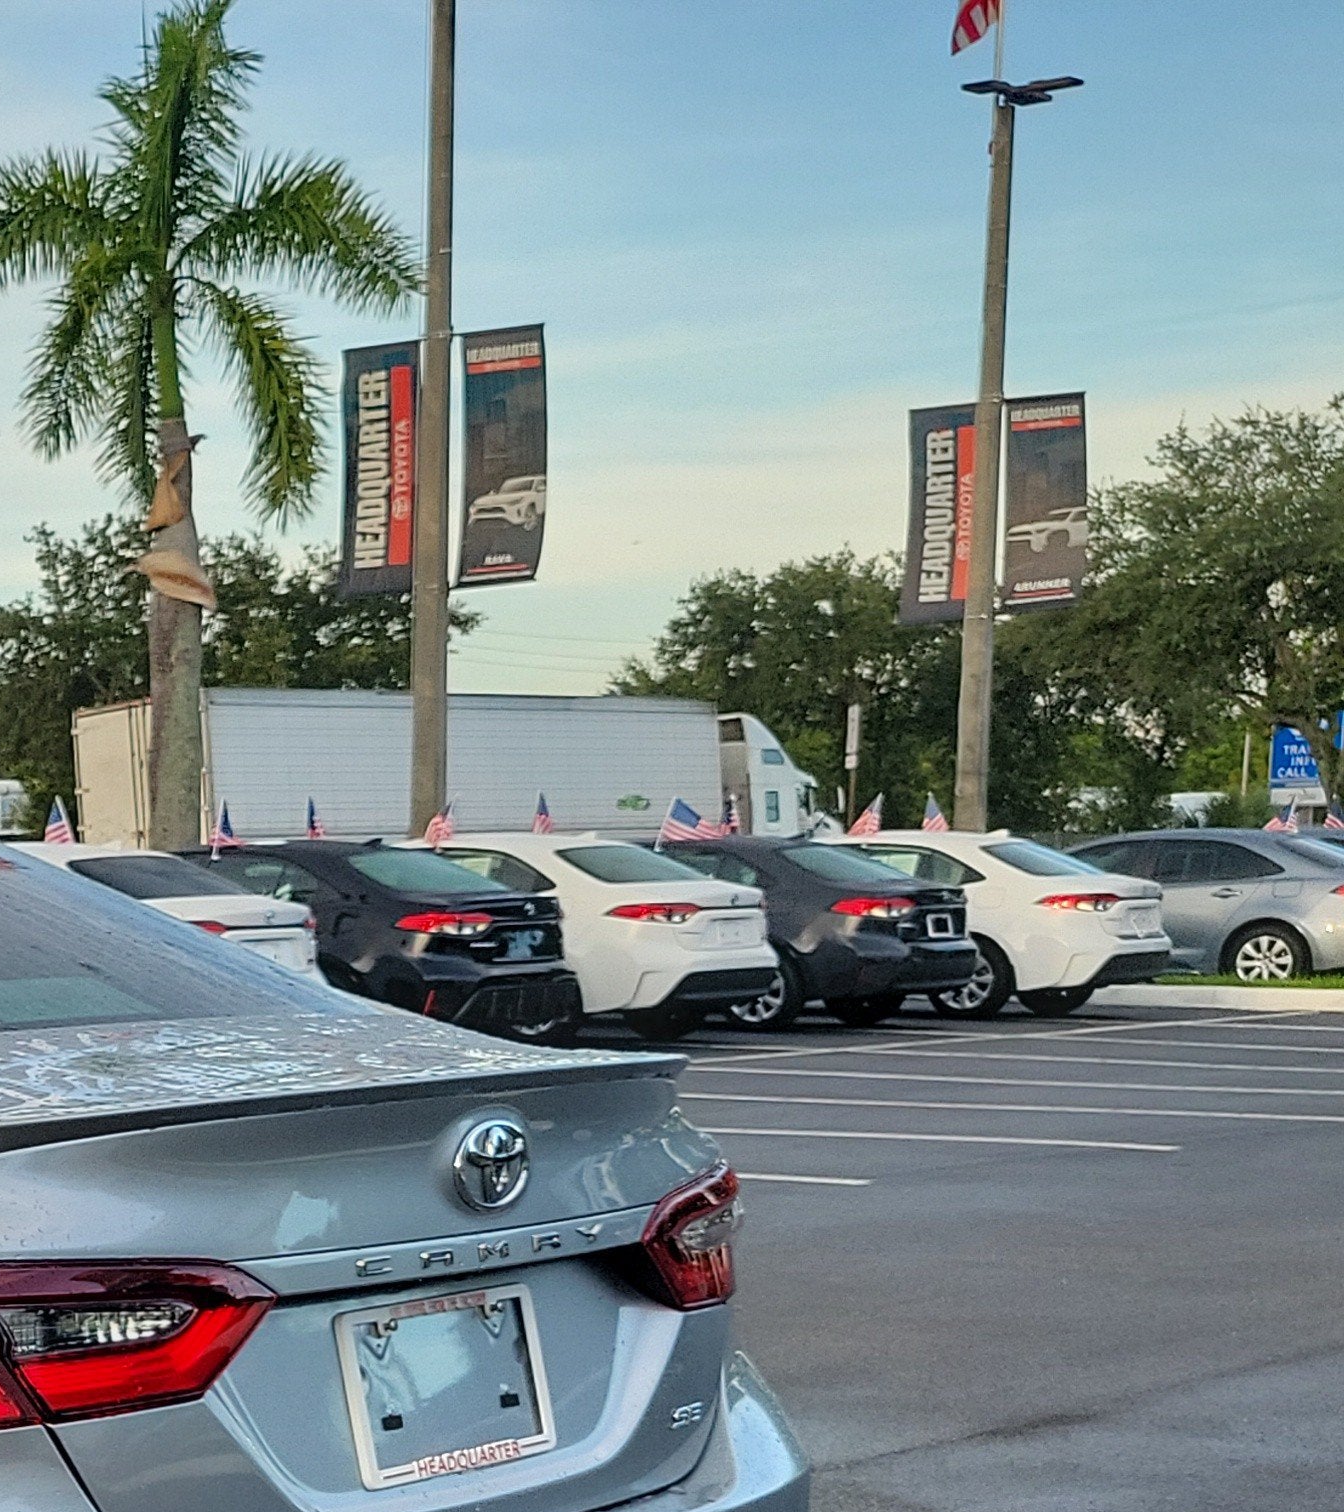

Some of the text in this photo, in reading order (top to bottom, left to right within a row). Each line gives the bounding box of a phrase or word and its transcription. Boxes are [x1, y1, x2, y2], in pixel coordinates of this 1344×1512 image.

[353, 369, 390, 569] HEADQUARTER
[918, 429, 956, 603] HEADQUARTER
[355, 1222, 605, 1278] CAMRY
[672, 1401, 703, 1429] SE
[414, 1440, 521, 1477] HEADQUARTER
